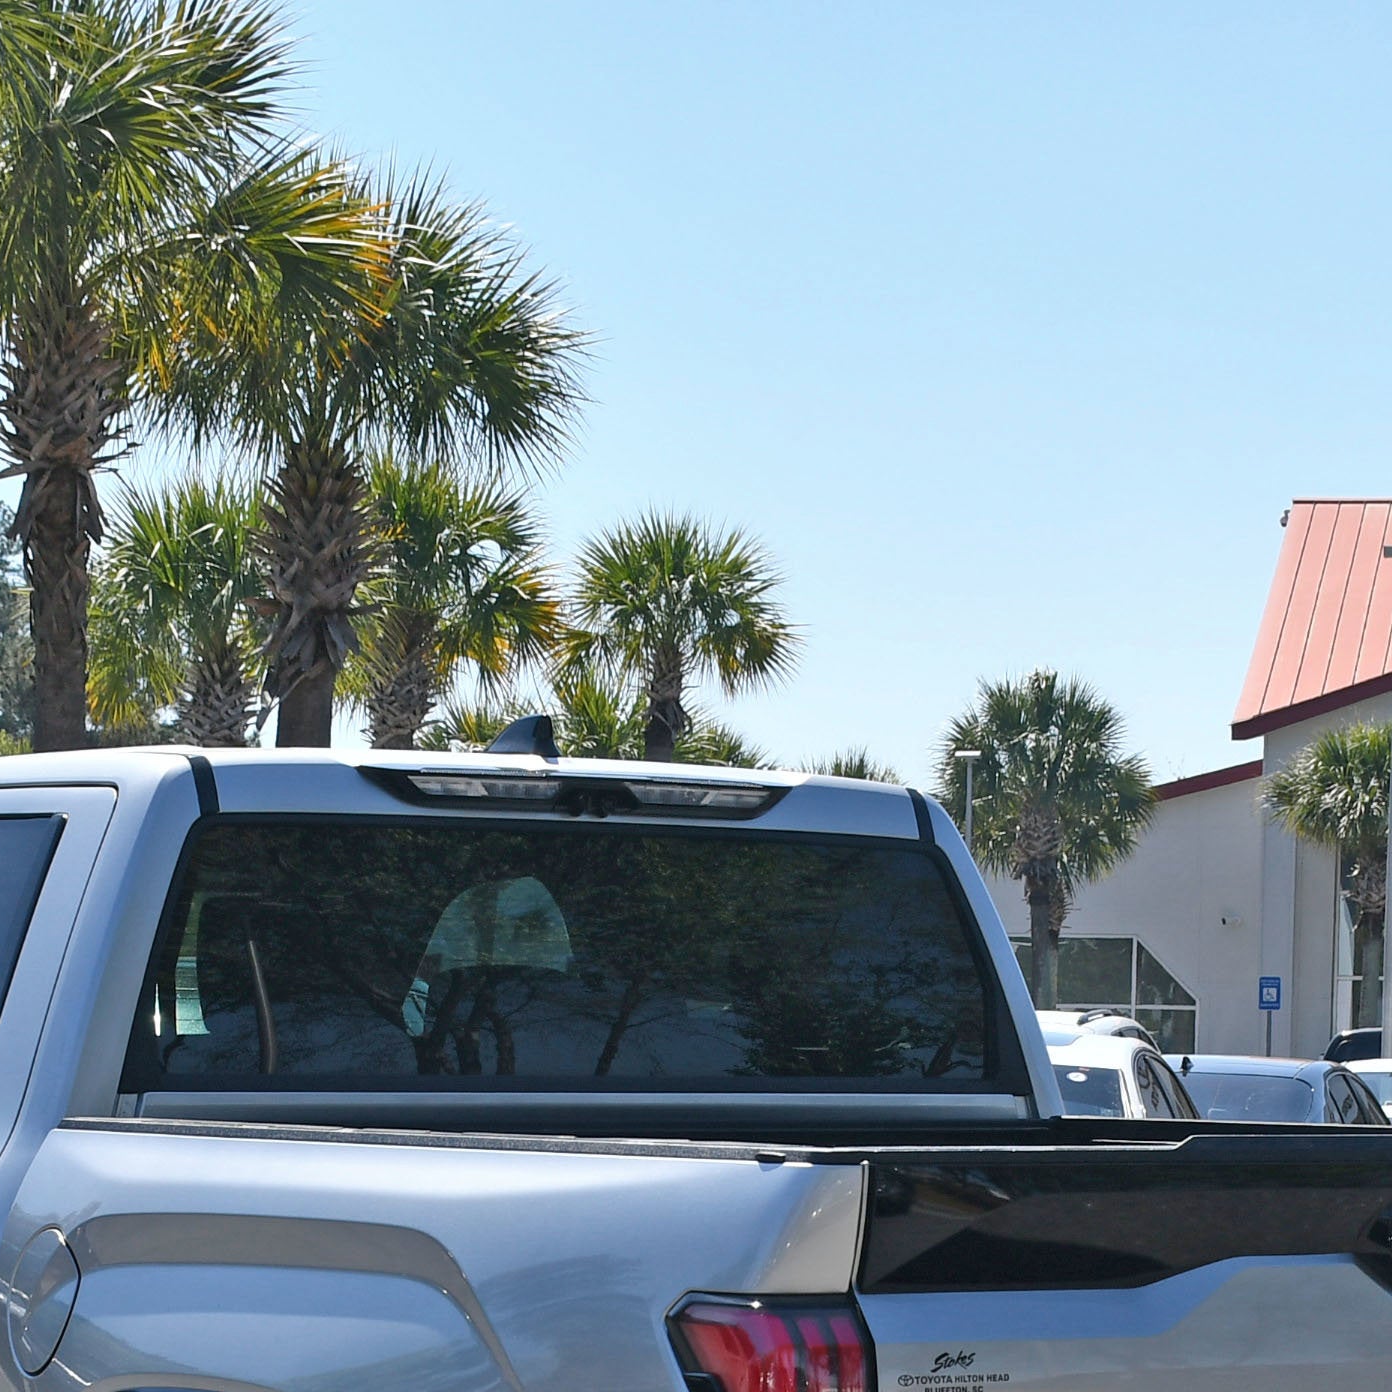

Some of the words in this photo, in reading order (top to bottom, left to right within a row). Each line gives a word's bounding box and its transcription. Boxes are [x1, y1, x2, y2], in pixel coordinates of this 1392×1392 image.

[931, 1350, 976, 1373] Stokes
[914, 1375, 953, 1385] TOYOTA
[954, 1375, 984, 1384] HILTON
[986, 1373, 1010, 1382] HEAD
